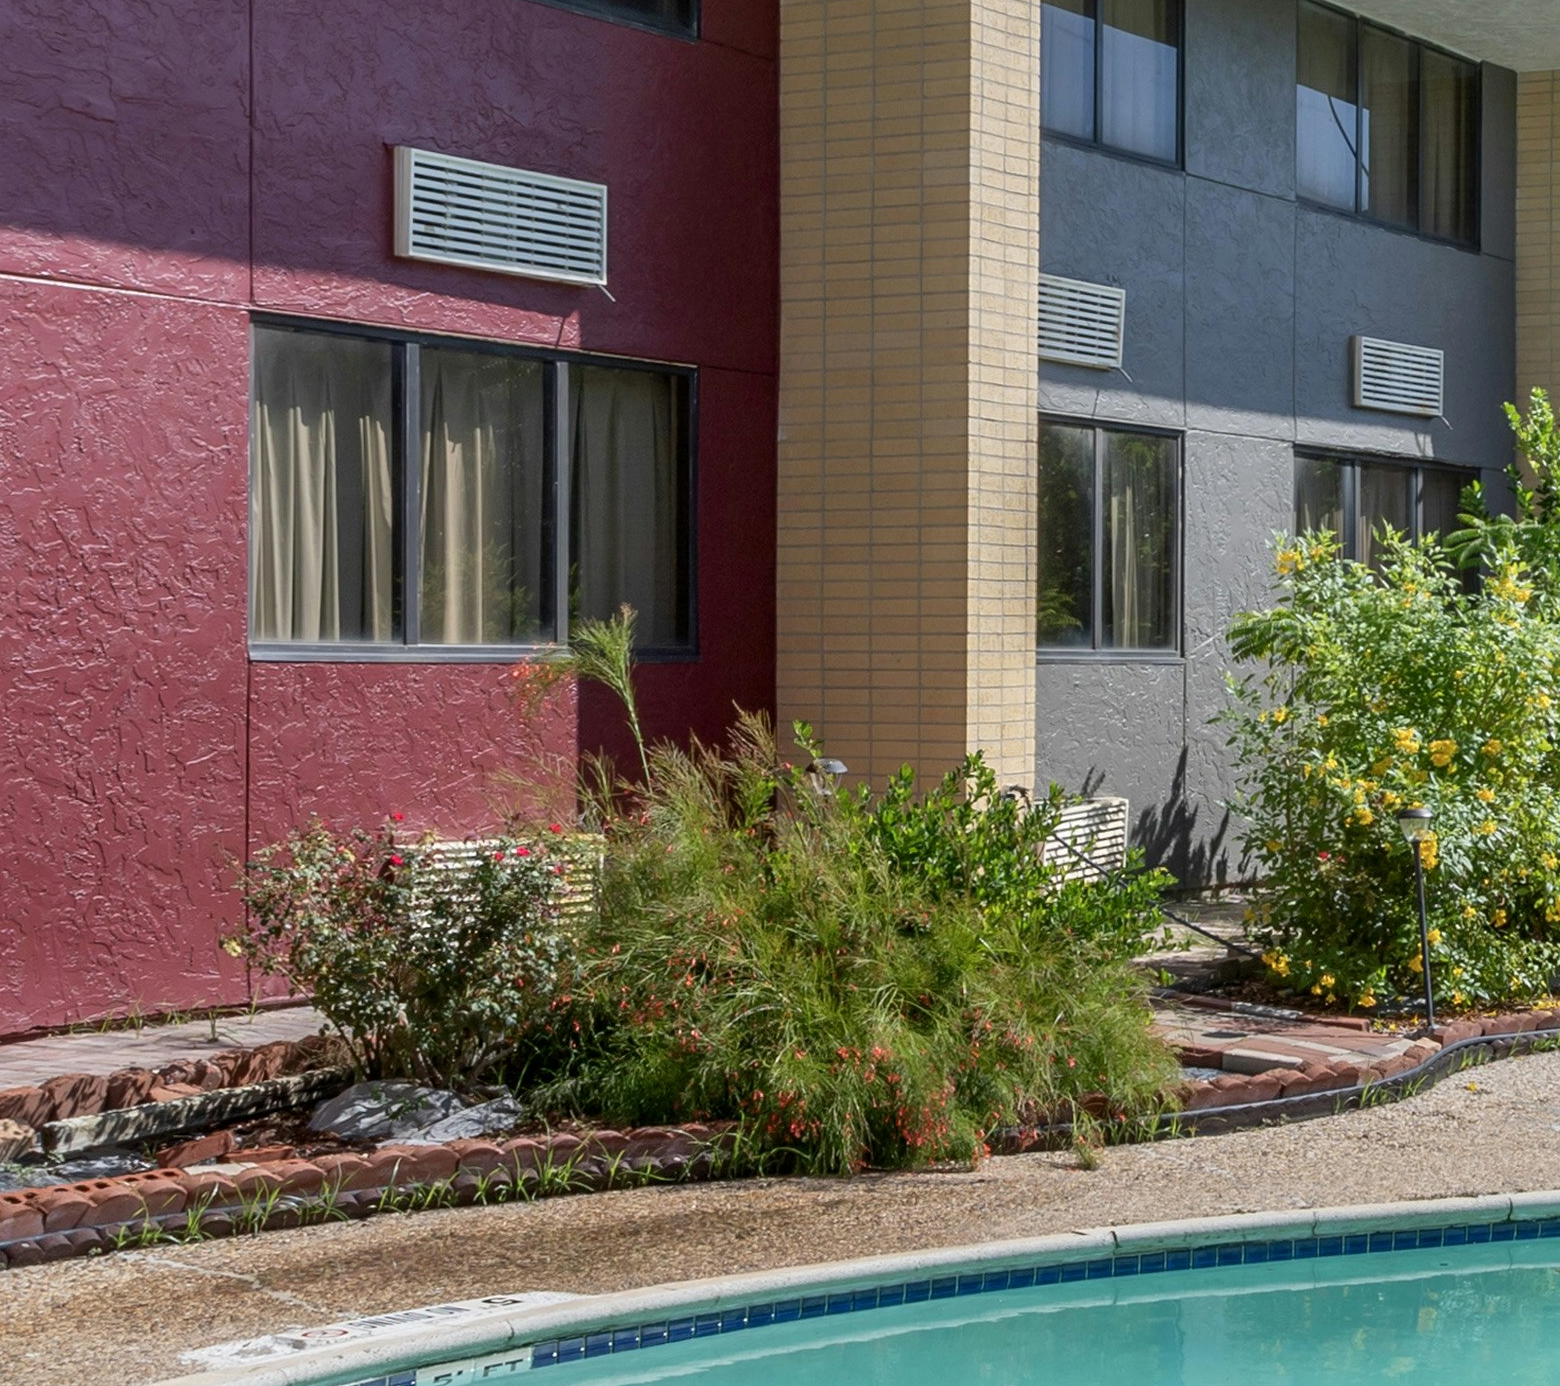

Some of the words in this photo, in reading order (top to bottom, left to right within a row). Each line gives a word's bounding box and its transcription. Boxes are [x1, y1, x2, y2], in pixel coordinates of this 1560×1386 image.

[481, 1297, 524, 1306] 5
[426, 1305, 471, 1315] NO
[483, 1359, 523, 1377] FT
